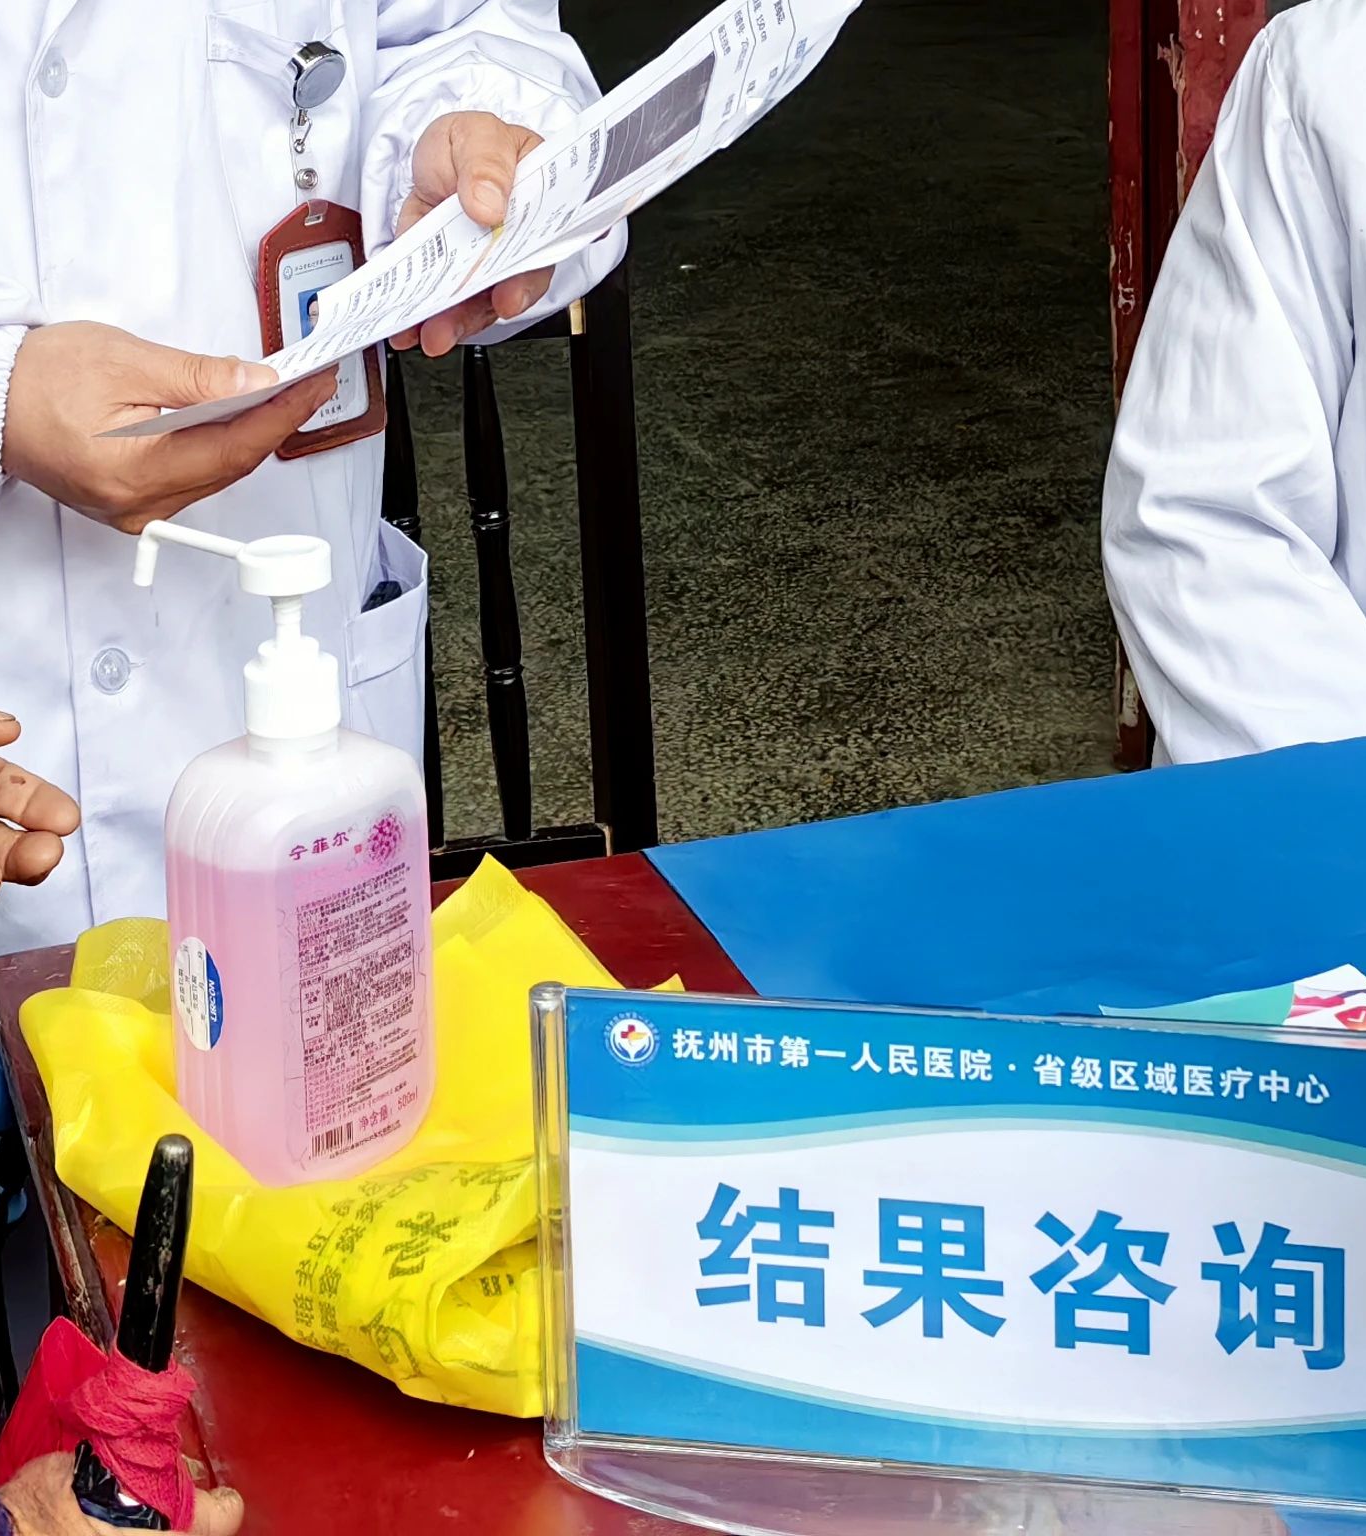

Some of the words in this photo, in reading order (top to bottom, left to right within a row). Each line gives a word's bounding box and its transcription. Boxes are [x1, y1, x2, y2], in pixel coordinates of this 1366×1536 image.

[288, 830, 351, 862] 宁菲尔
[695, 1181, 1347, 1372] 结果咨询
